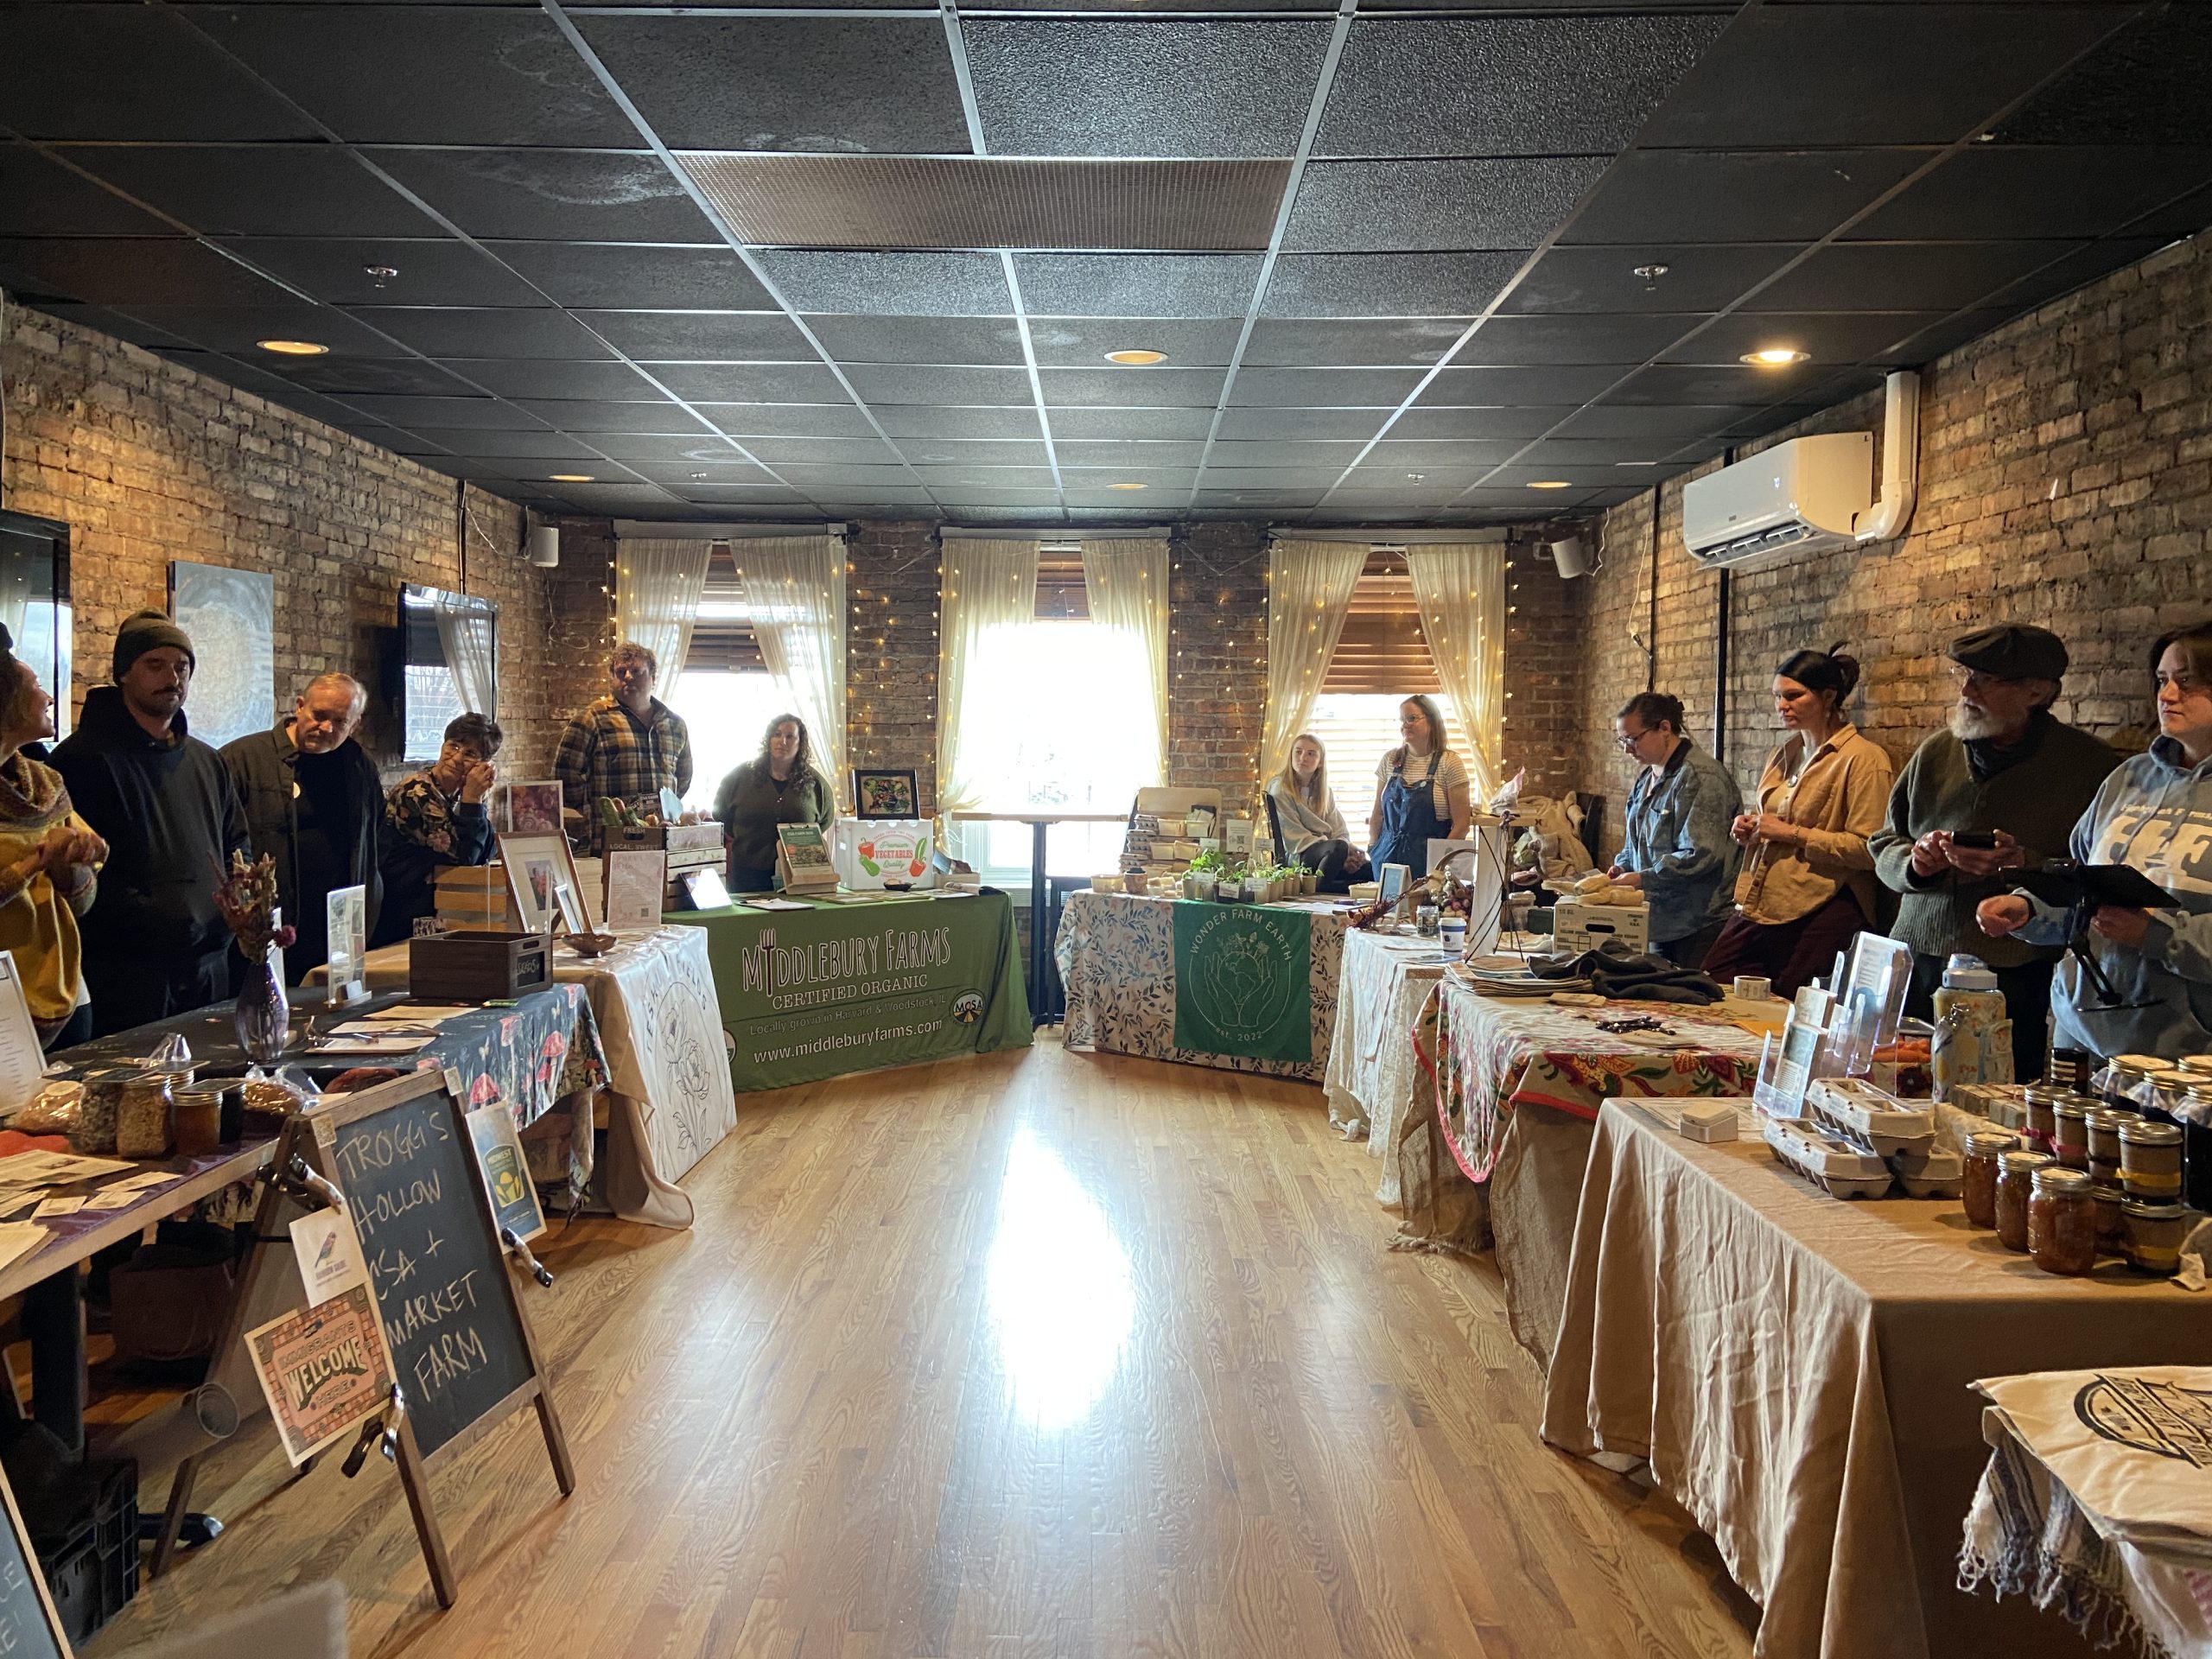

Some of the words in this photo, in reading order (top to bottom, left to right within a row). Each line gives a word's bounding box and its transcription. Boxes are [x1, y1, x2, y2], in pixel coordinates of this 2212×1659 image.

[1190, 912, 1227, 954] WONDER
[1231, 909, 1263, 925] FARM
[1265, 921, 1293, 961] EARTH
[742, 928, 879, 997] MIDDLEBURY
[885, 926, 950, 971] FARMS
[750, 1020, 786, 1036] Locally
[790, 1016, 821, 1032] grown
[823, 1013, 834, 1022] in
[836, 1007, 872, 1020] Harvard
[874, 1003, 882, 1014] &
[939, 994, 947, 1004] IL
[772, 983, 857, 1010] CERTIFIED
[861, 974, 928, 995] ORGANIC
[955, 1000, 982, 1013] MOSA
[753, 1019, 943, 1064] www.middleburyfarms.com
[1237, 1030, 1262, 1042] 2022
[350, 1168, 442, 1245] HOLLOW
[385, 1268, 479, 1349] MARKET
[278, 1320, 357, 1369] IMMIGRANTS
[413, 1326, 488, 1403] FARM
[283, 1337, 367, 1411] WELCOME
[315, 1380, 352, 1408] HERE
